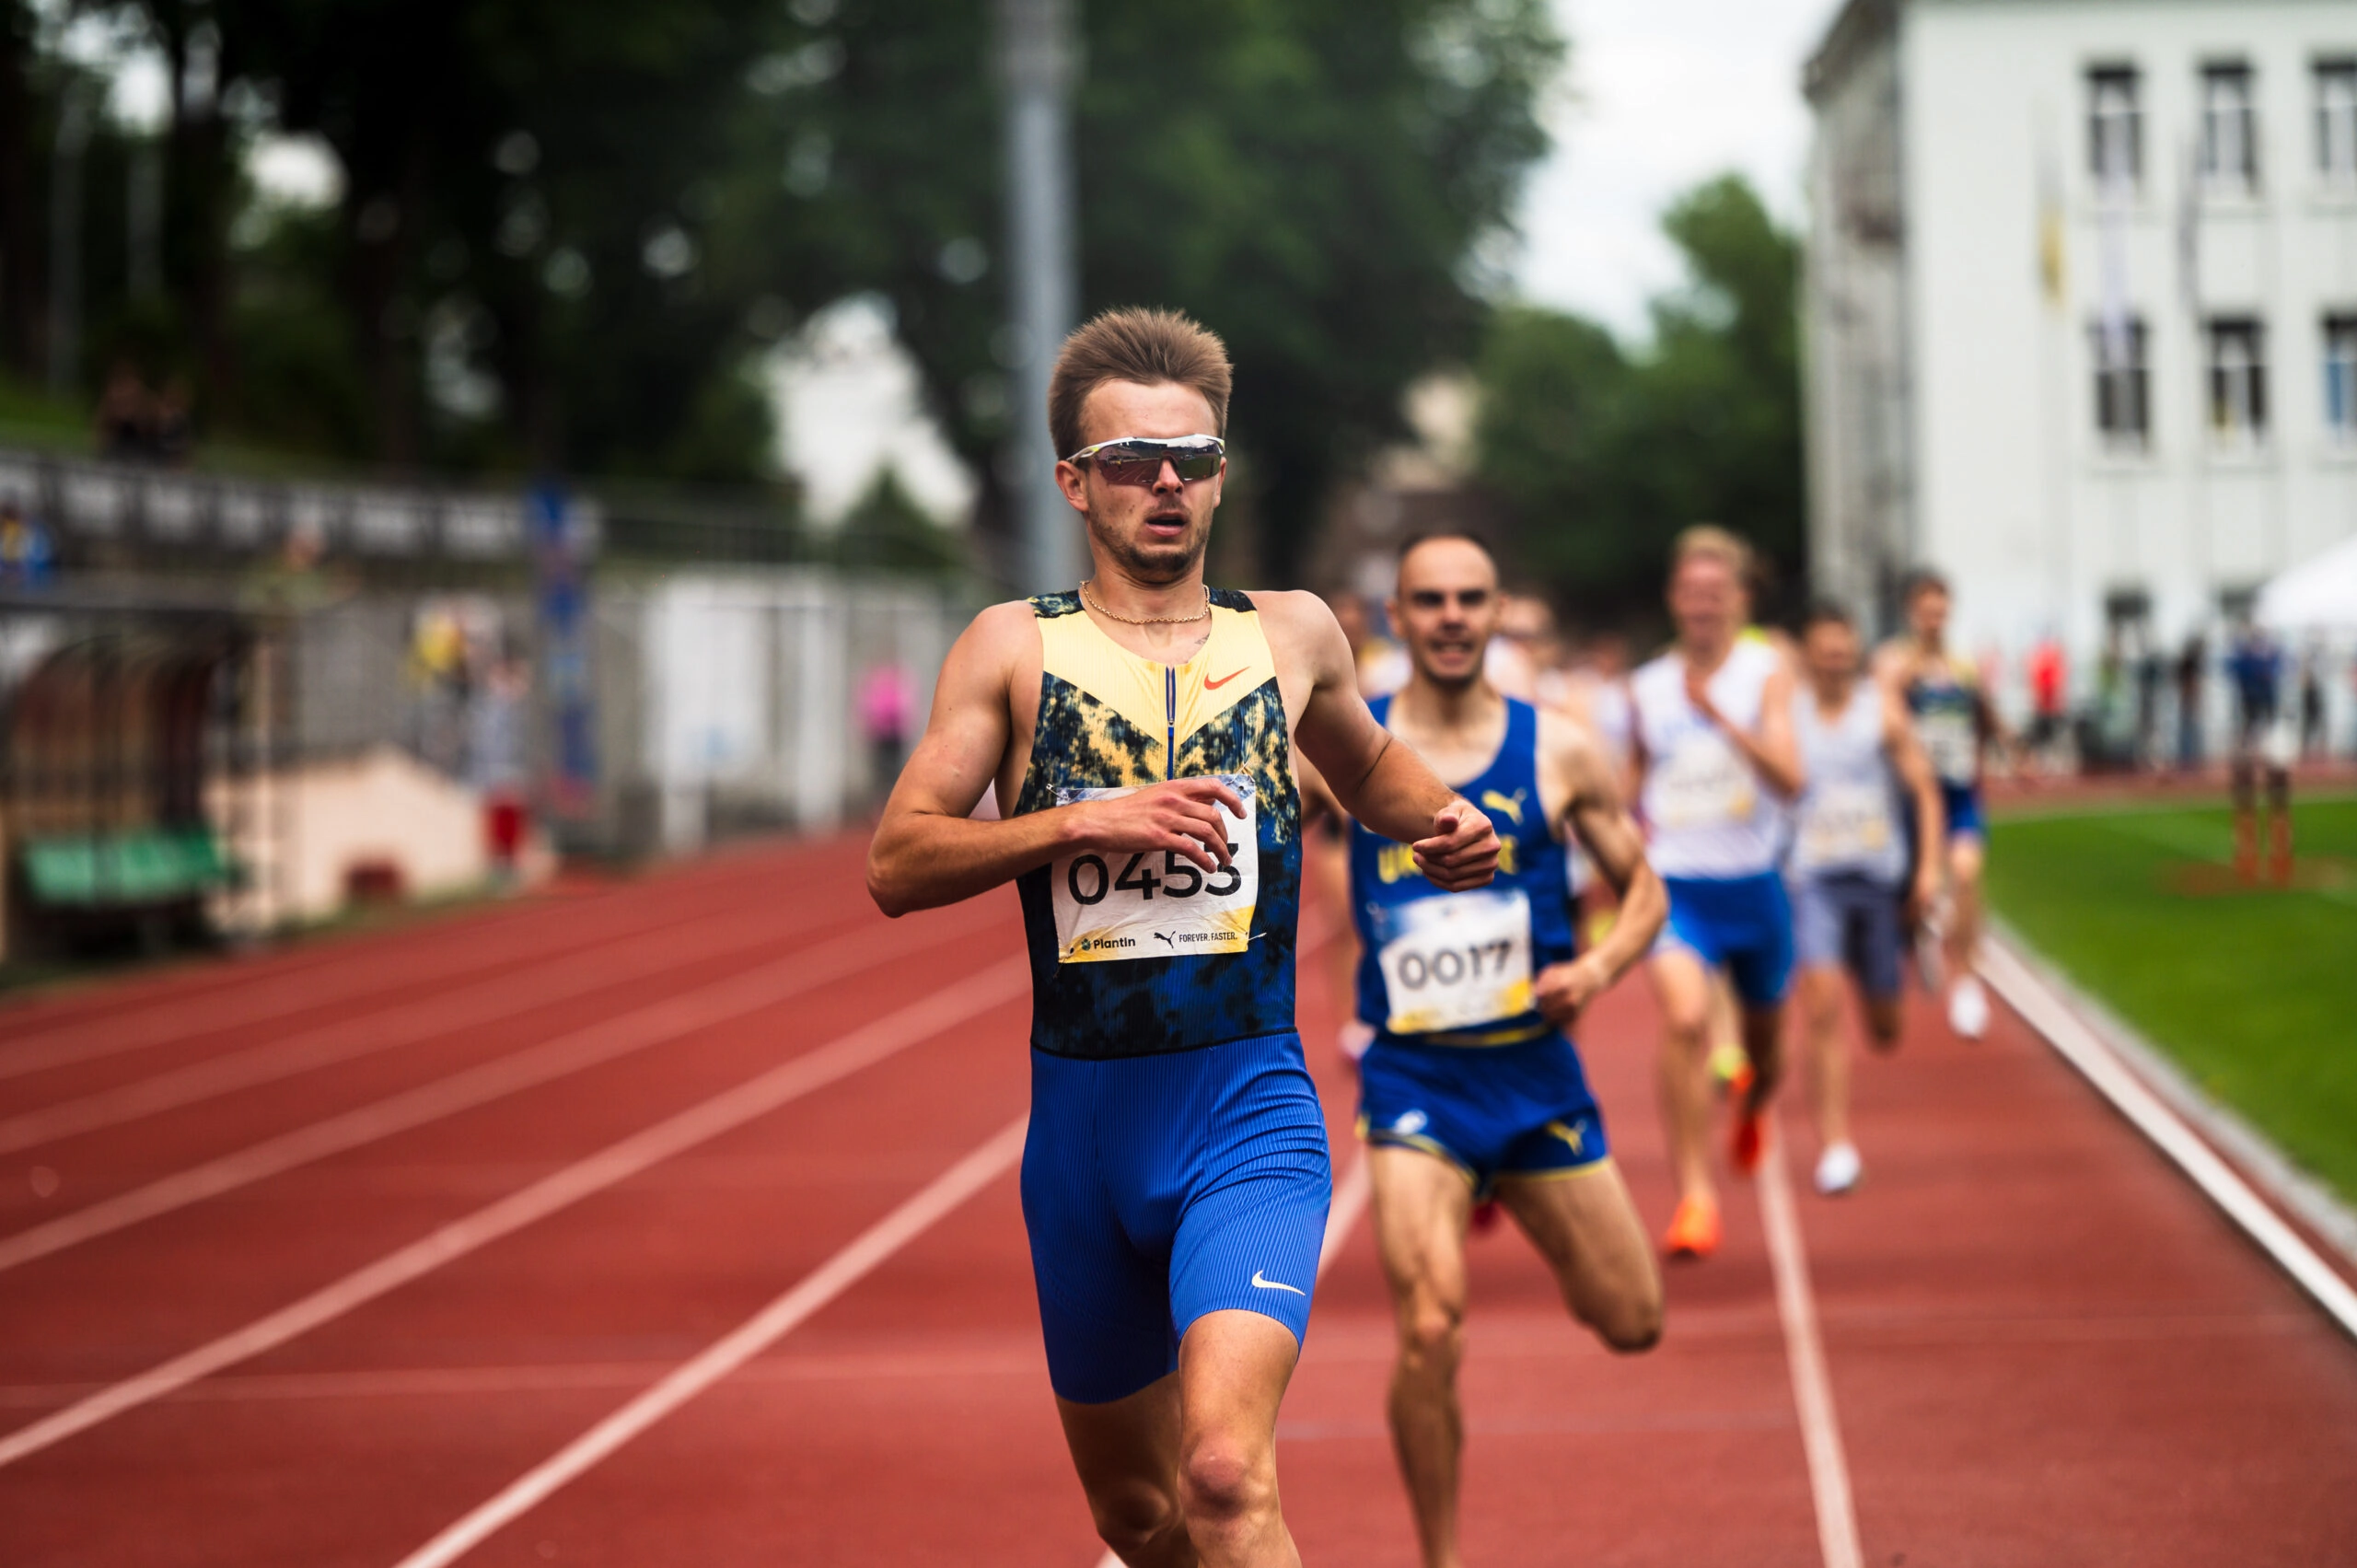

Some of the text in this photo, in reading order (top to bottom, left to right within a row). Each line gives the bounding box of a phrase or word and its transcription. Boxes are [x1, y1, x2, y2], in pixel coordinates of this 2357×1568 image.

[1068, 842, 1242, 905] 0453
[1093, 936, 1136, 949] Plantin
[1211, 931, 1238, 941] FASTER.
[1397, 940, 1513, 989] 0017
